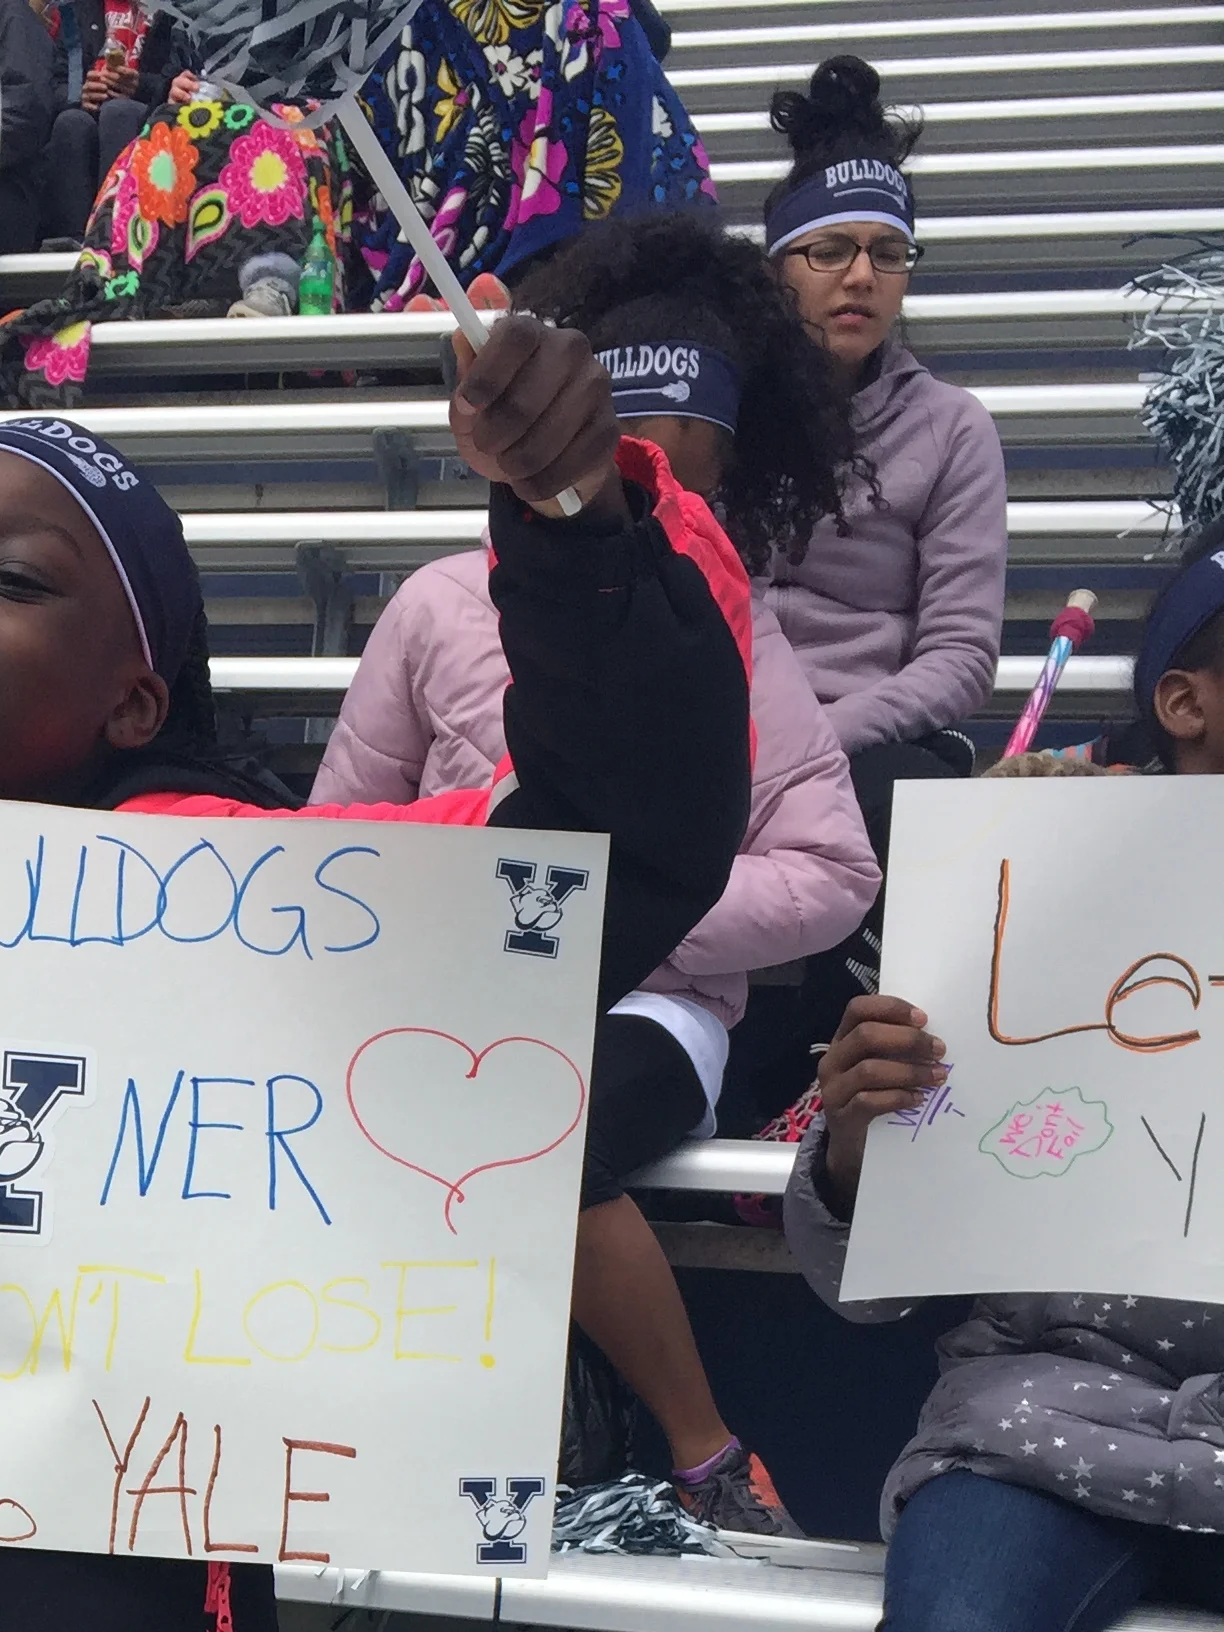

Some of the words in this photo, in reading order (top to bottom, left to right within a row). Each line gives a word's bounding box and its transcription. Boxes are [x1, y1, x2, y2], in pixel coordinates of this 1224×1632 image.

[594, 344, 700, 379] ULLDOGS
[99, 1070, 332, 1226] NER
[183, 1256, 499, 1369] LOSE!
[92, 1396, 357, 1563] YALE
